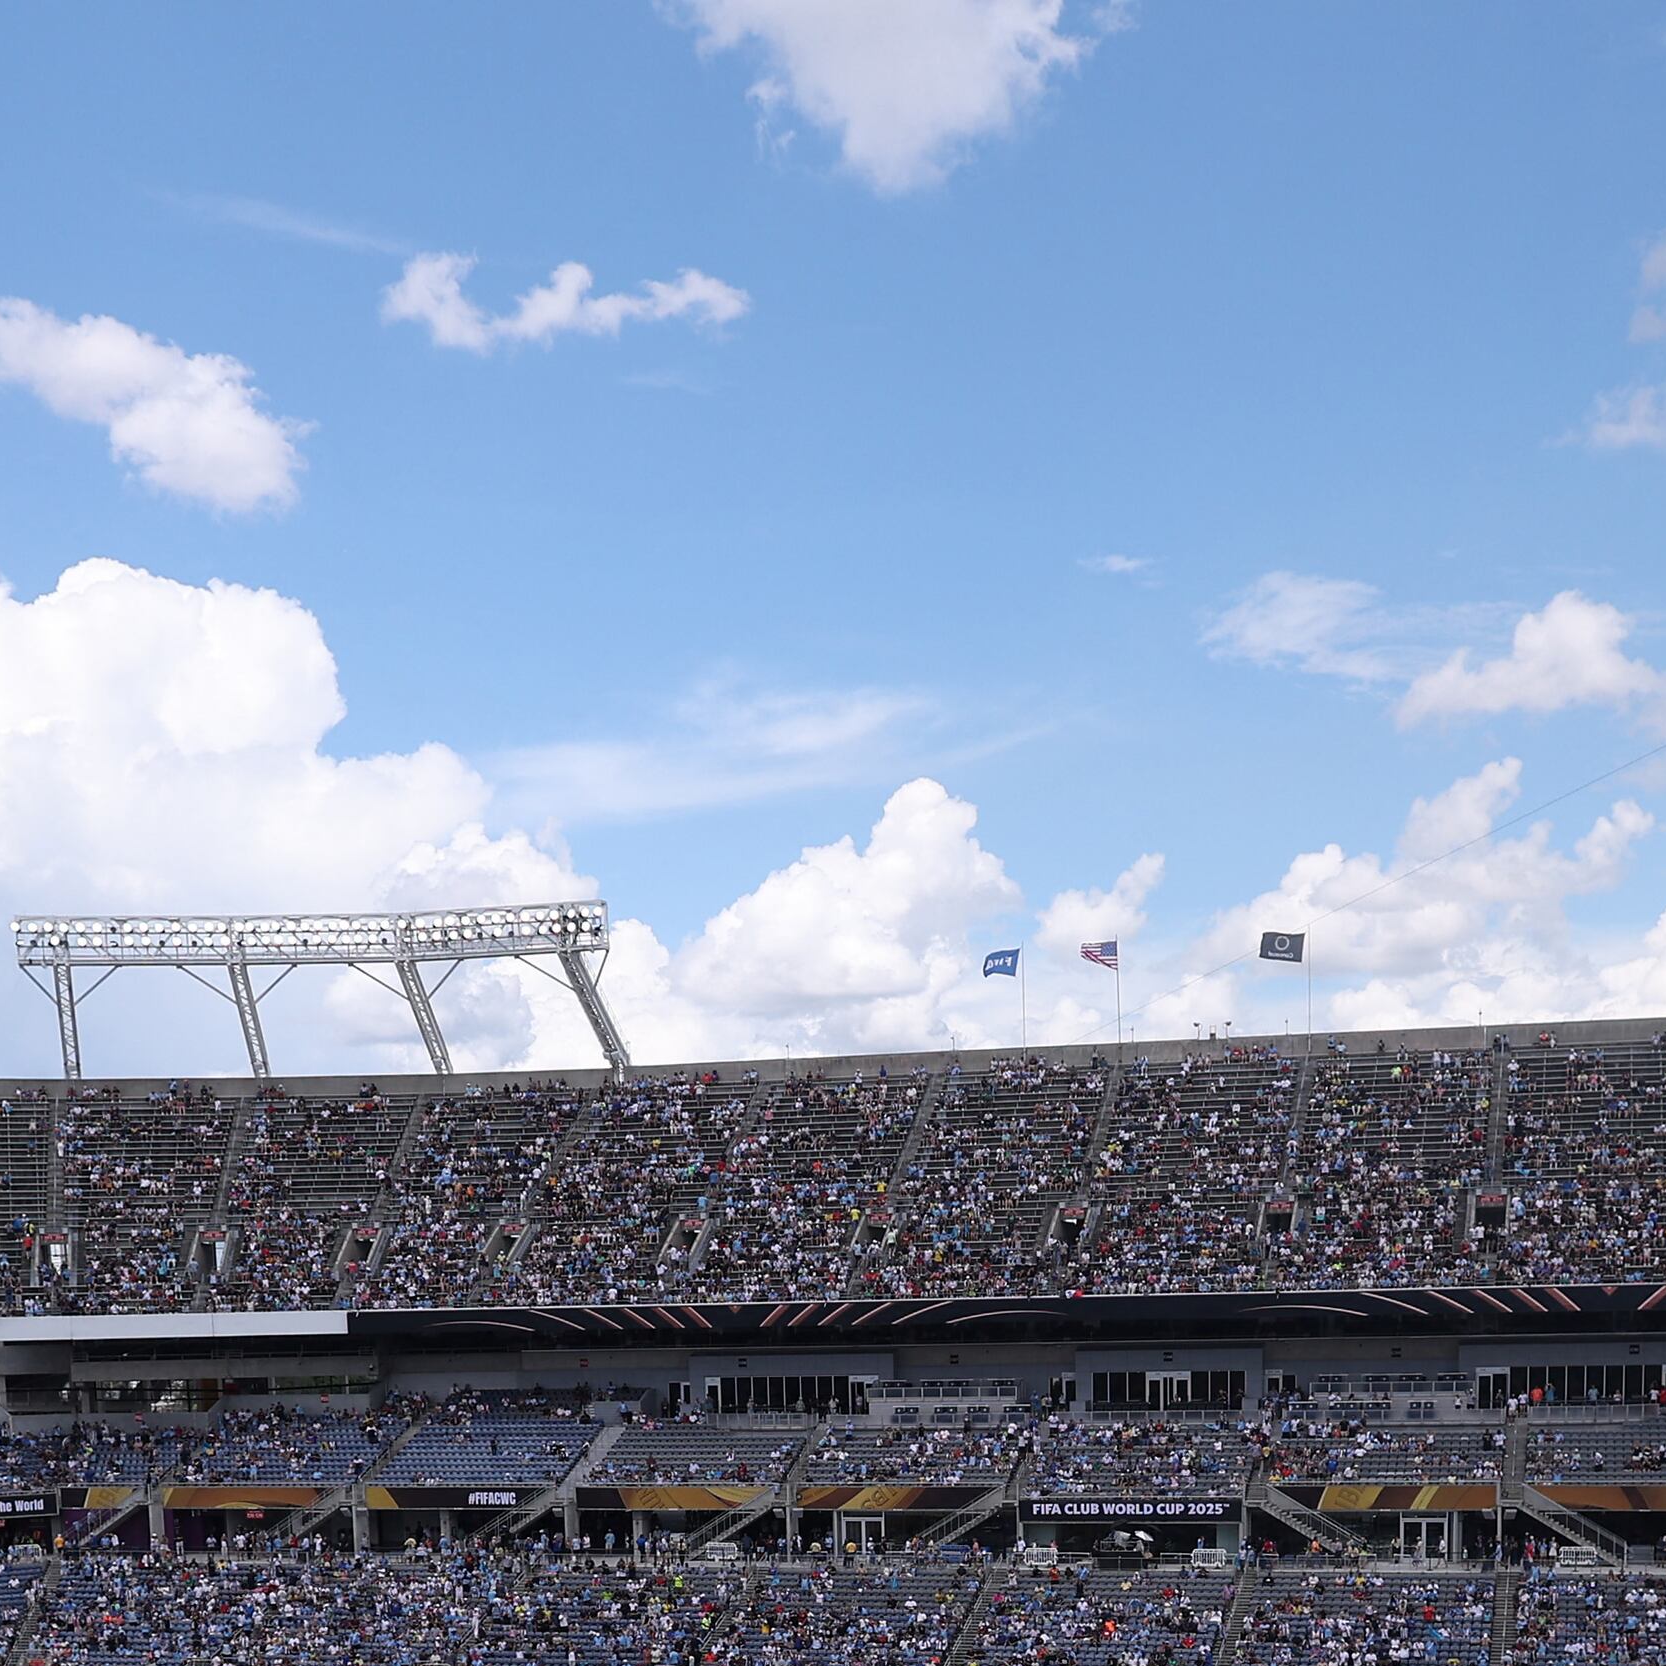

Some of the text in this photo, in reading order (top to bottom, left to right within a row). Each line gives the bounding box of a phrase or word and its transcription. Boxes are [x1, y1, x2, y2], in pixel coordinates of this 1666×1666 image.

[468, 1491, 517, 1505] #FIFACWC
[13, 1499, 44, 1512] World
[1032, 1503, 1062, 1515] FIFA
[1064, 1502, 1100, 1515] CLUB
[1102, 1502, 1154, 1515] WORLD
[1156, 1502, 1184, 1515] CUP
